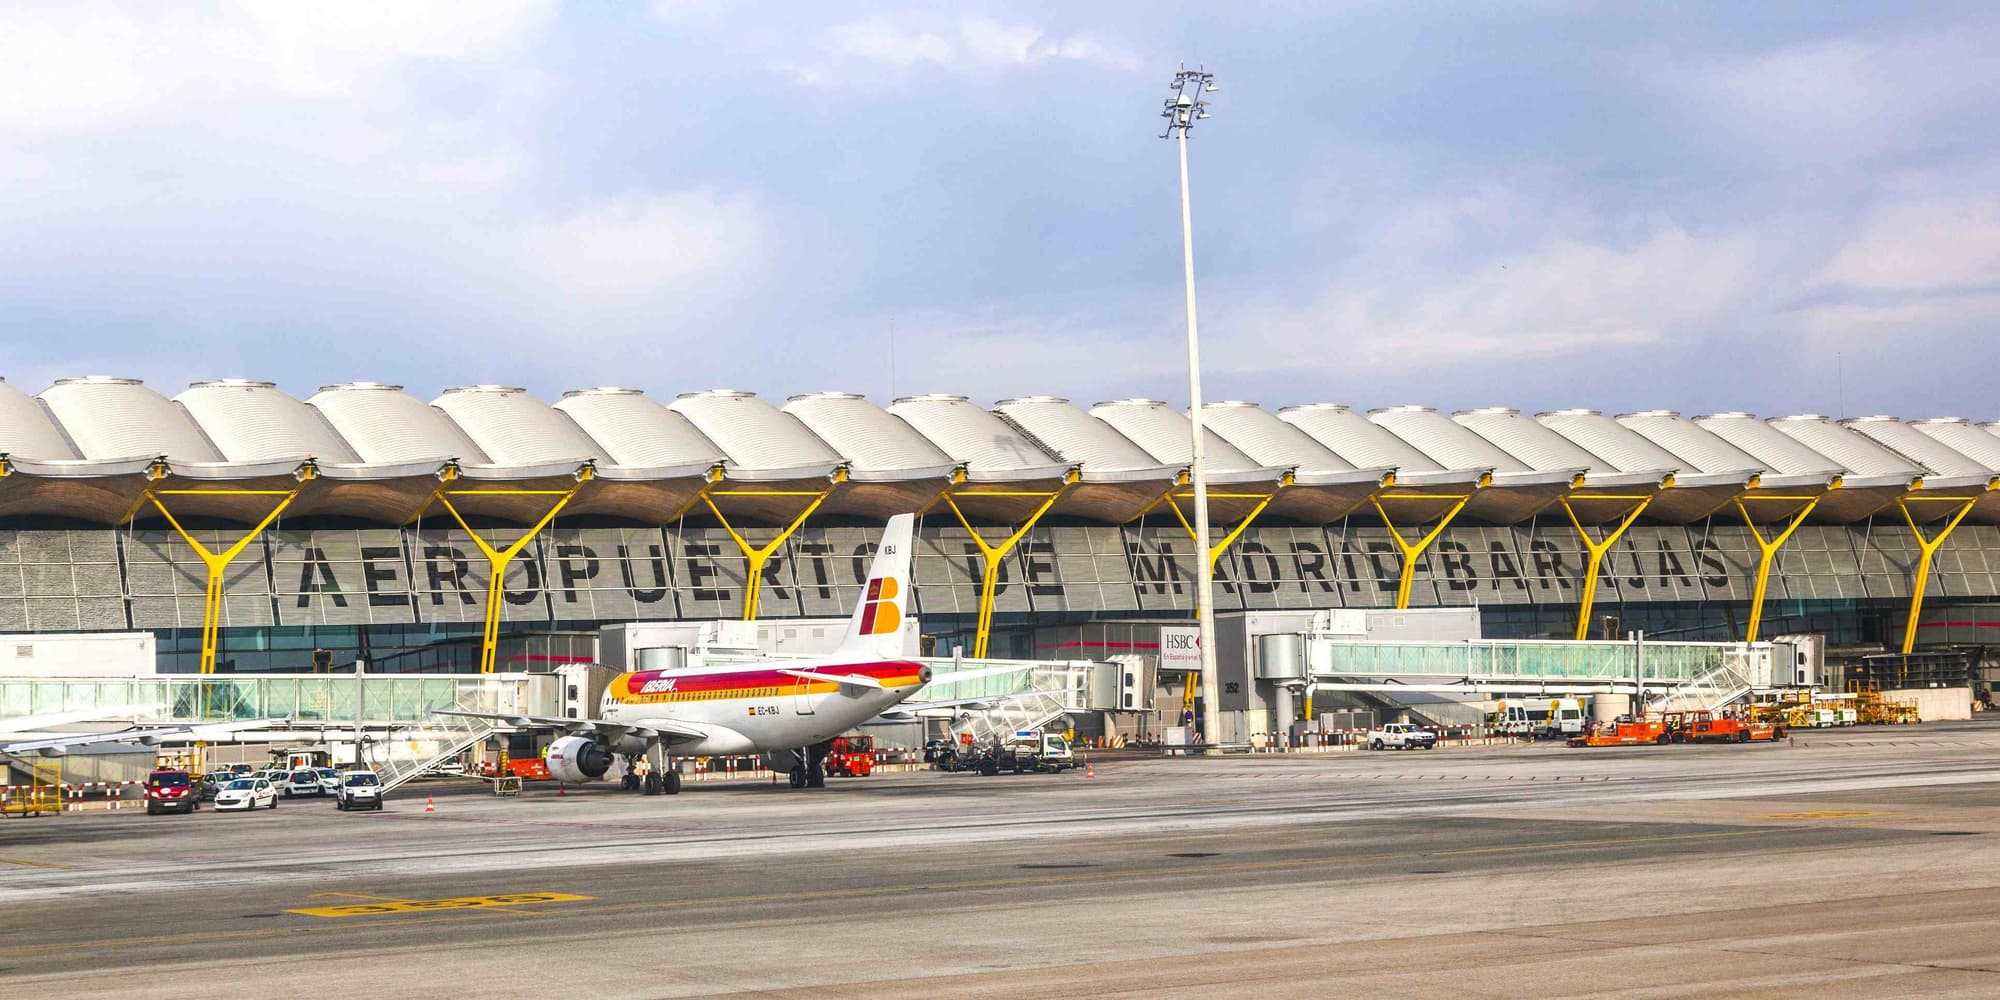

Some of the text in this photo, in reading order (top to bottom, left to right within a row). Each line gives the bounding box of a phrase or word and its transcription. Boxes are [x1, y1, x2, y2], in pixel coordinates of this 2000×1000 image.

[884, 545, 896, 555] KBJ
[964, 543, 1064, 596] DE
[1166, 634, 1194, 649] HSBC
[640, 679, 677, 694] IBERIA
[1224, 682, 1240, 694] 352
[757, 706, 780, 716] EC-KBJ
